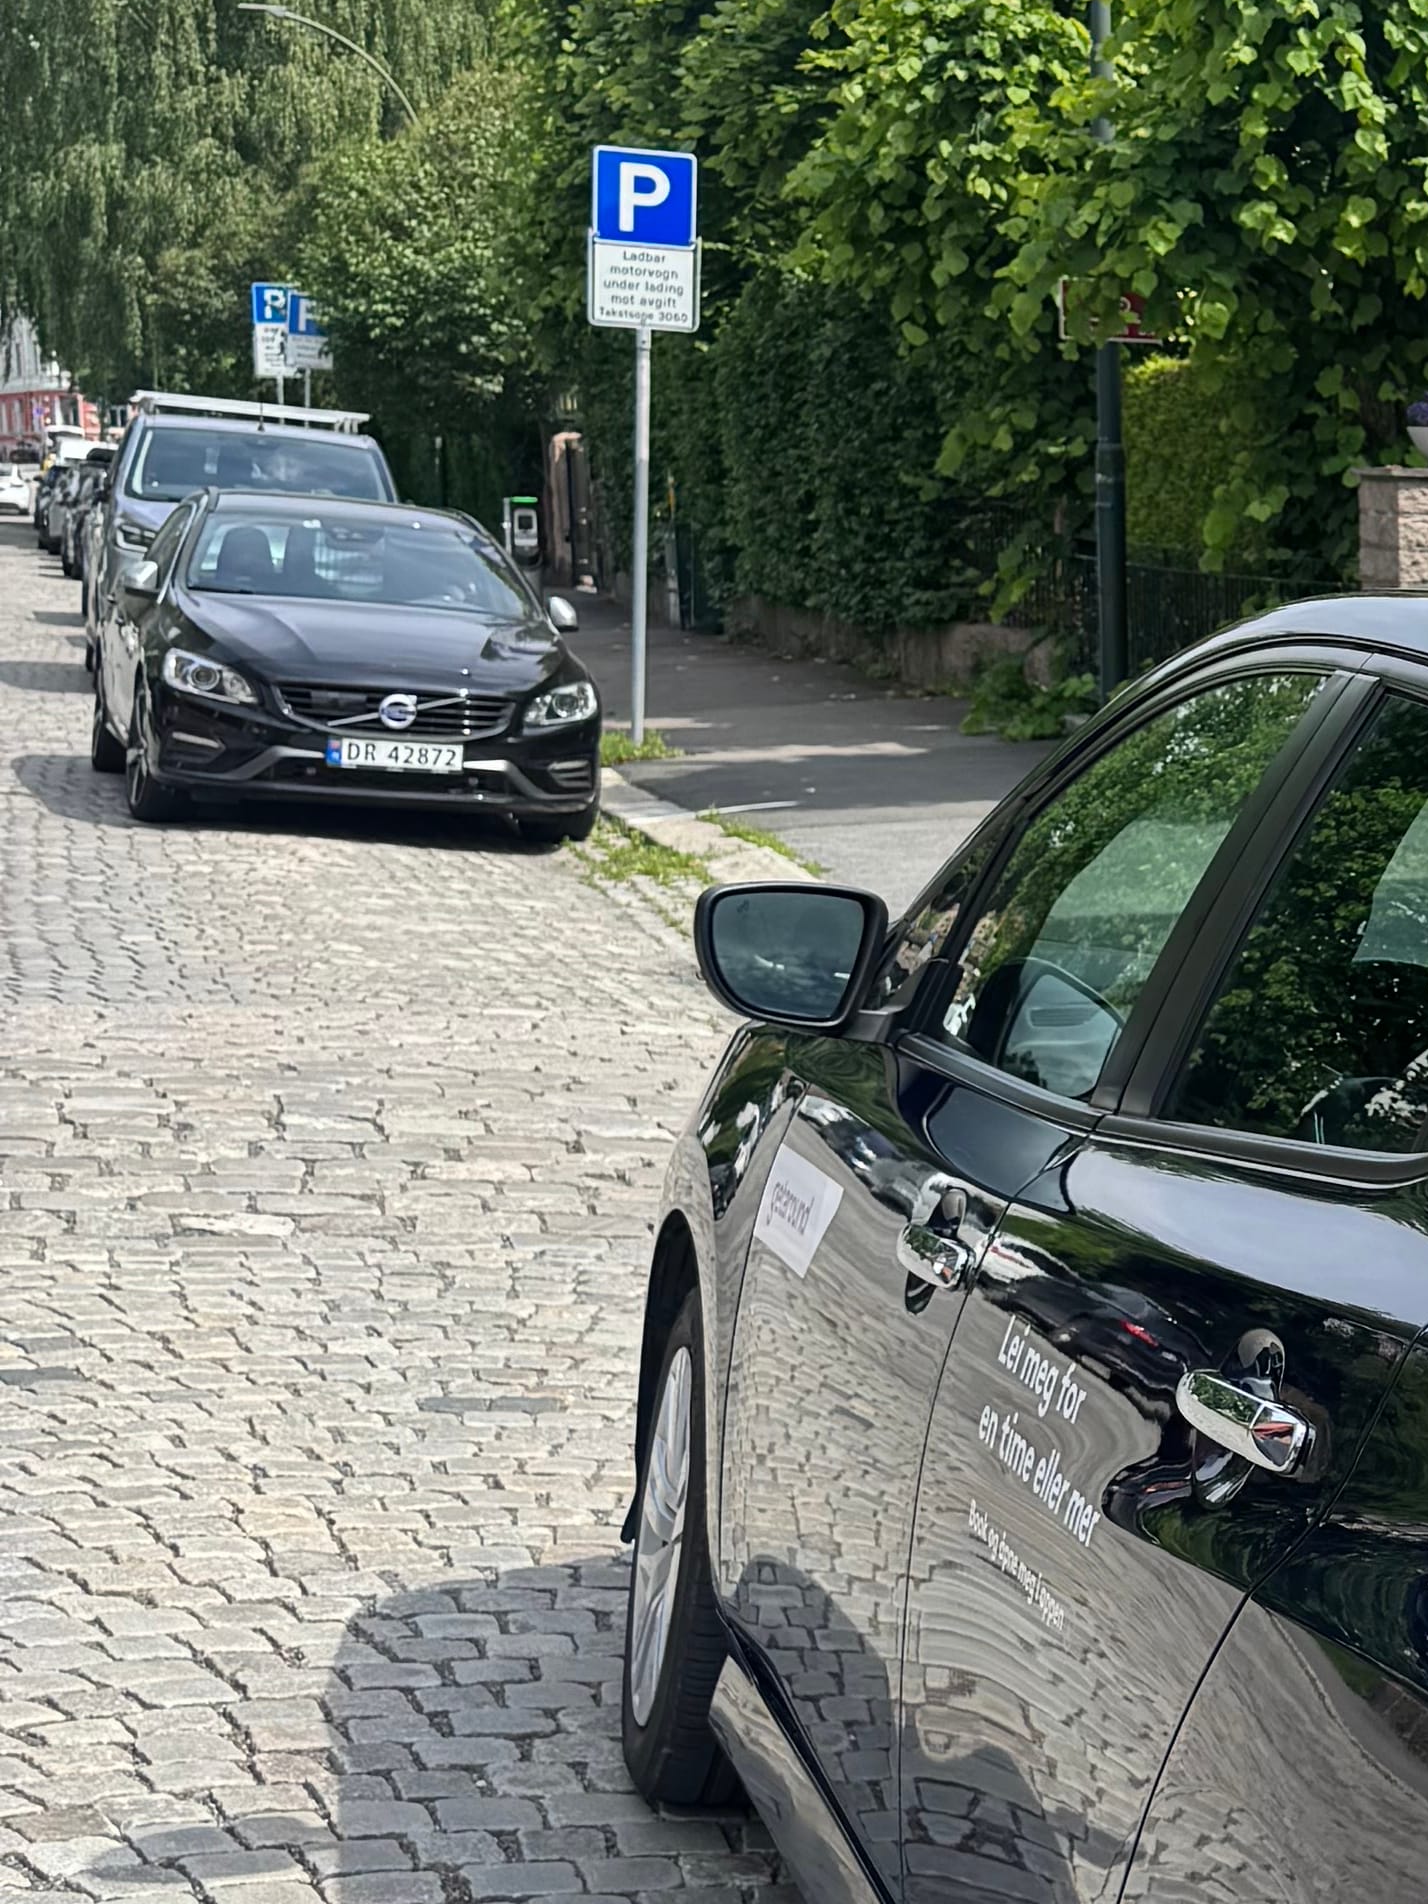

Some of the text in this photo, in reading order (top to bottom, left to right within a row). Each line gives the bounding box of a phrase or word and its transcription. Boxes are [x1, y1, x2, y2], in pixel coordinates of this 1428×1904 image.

[618, 161, 671, 233] P
[623, 250, 666, 263] Ladbar
[610, 265, 678, 281] motorvogn
[603, 279, 684, 297] under lading
[610, 294, 676, 309] mot avgift
[347, 743, 376, 762] DR
[387, 746, 457, 767] 42872
[998, 1314, 1087, 1424] Lei meg for
[979, 1404, 1100, 1547] en time eller mer
